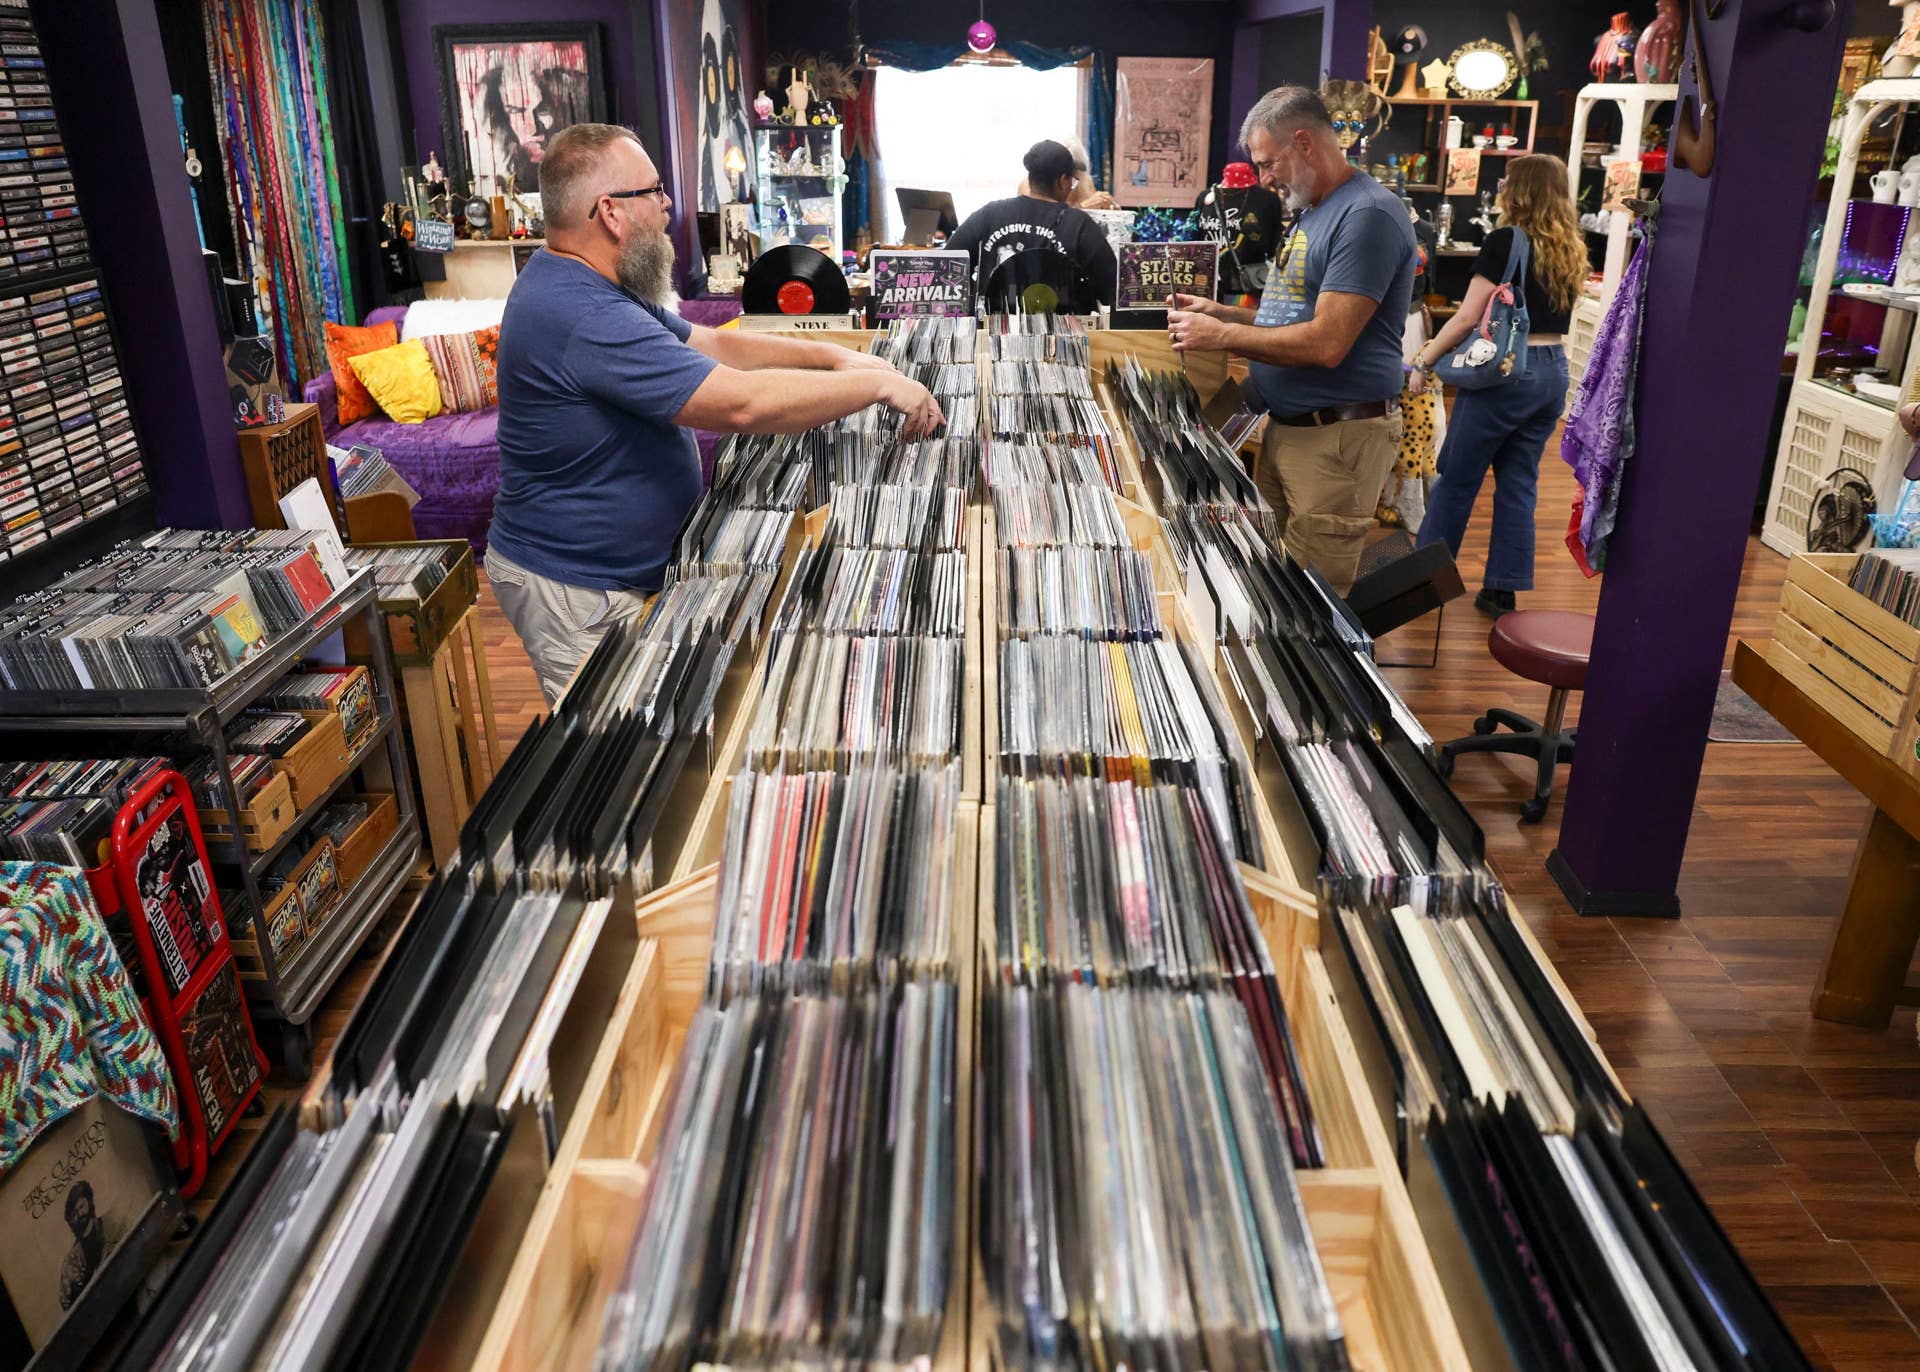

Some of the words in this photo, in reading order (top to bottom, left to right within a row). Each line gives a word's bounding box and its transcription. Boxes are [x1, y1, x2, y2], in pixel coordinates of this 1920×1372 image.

[984, 223, 1032, 252] INTRUSIVE
[896, 272, 935, 288] NEW
[1140, 260, 1195, 274] STAFF
[1141, 272, 1194, 286] PICKS
[881, 284, 963, 304] ARRIVALS
[793, 321, 831, 330] STEVE
[191, 644, 212, 688] badfinge
[149, 901, 188, 986] ALTERNATIVE
[162, 889, 199, 973] MUSIC
[196, 1064, 225, 1135] HEAVY
[52, 1119, 108, 1182] CLAPTON
[22, 1176, 48, 1213] ERIC
[31, 1137, 105, 1221] CROSSROADS
